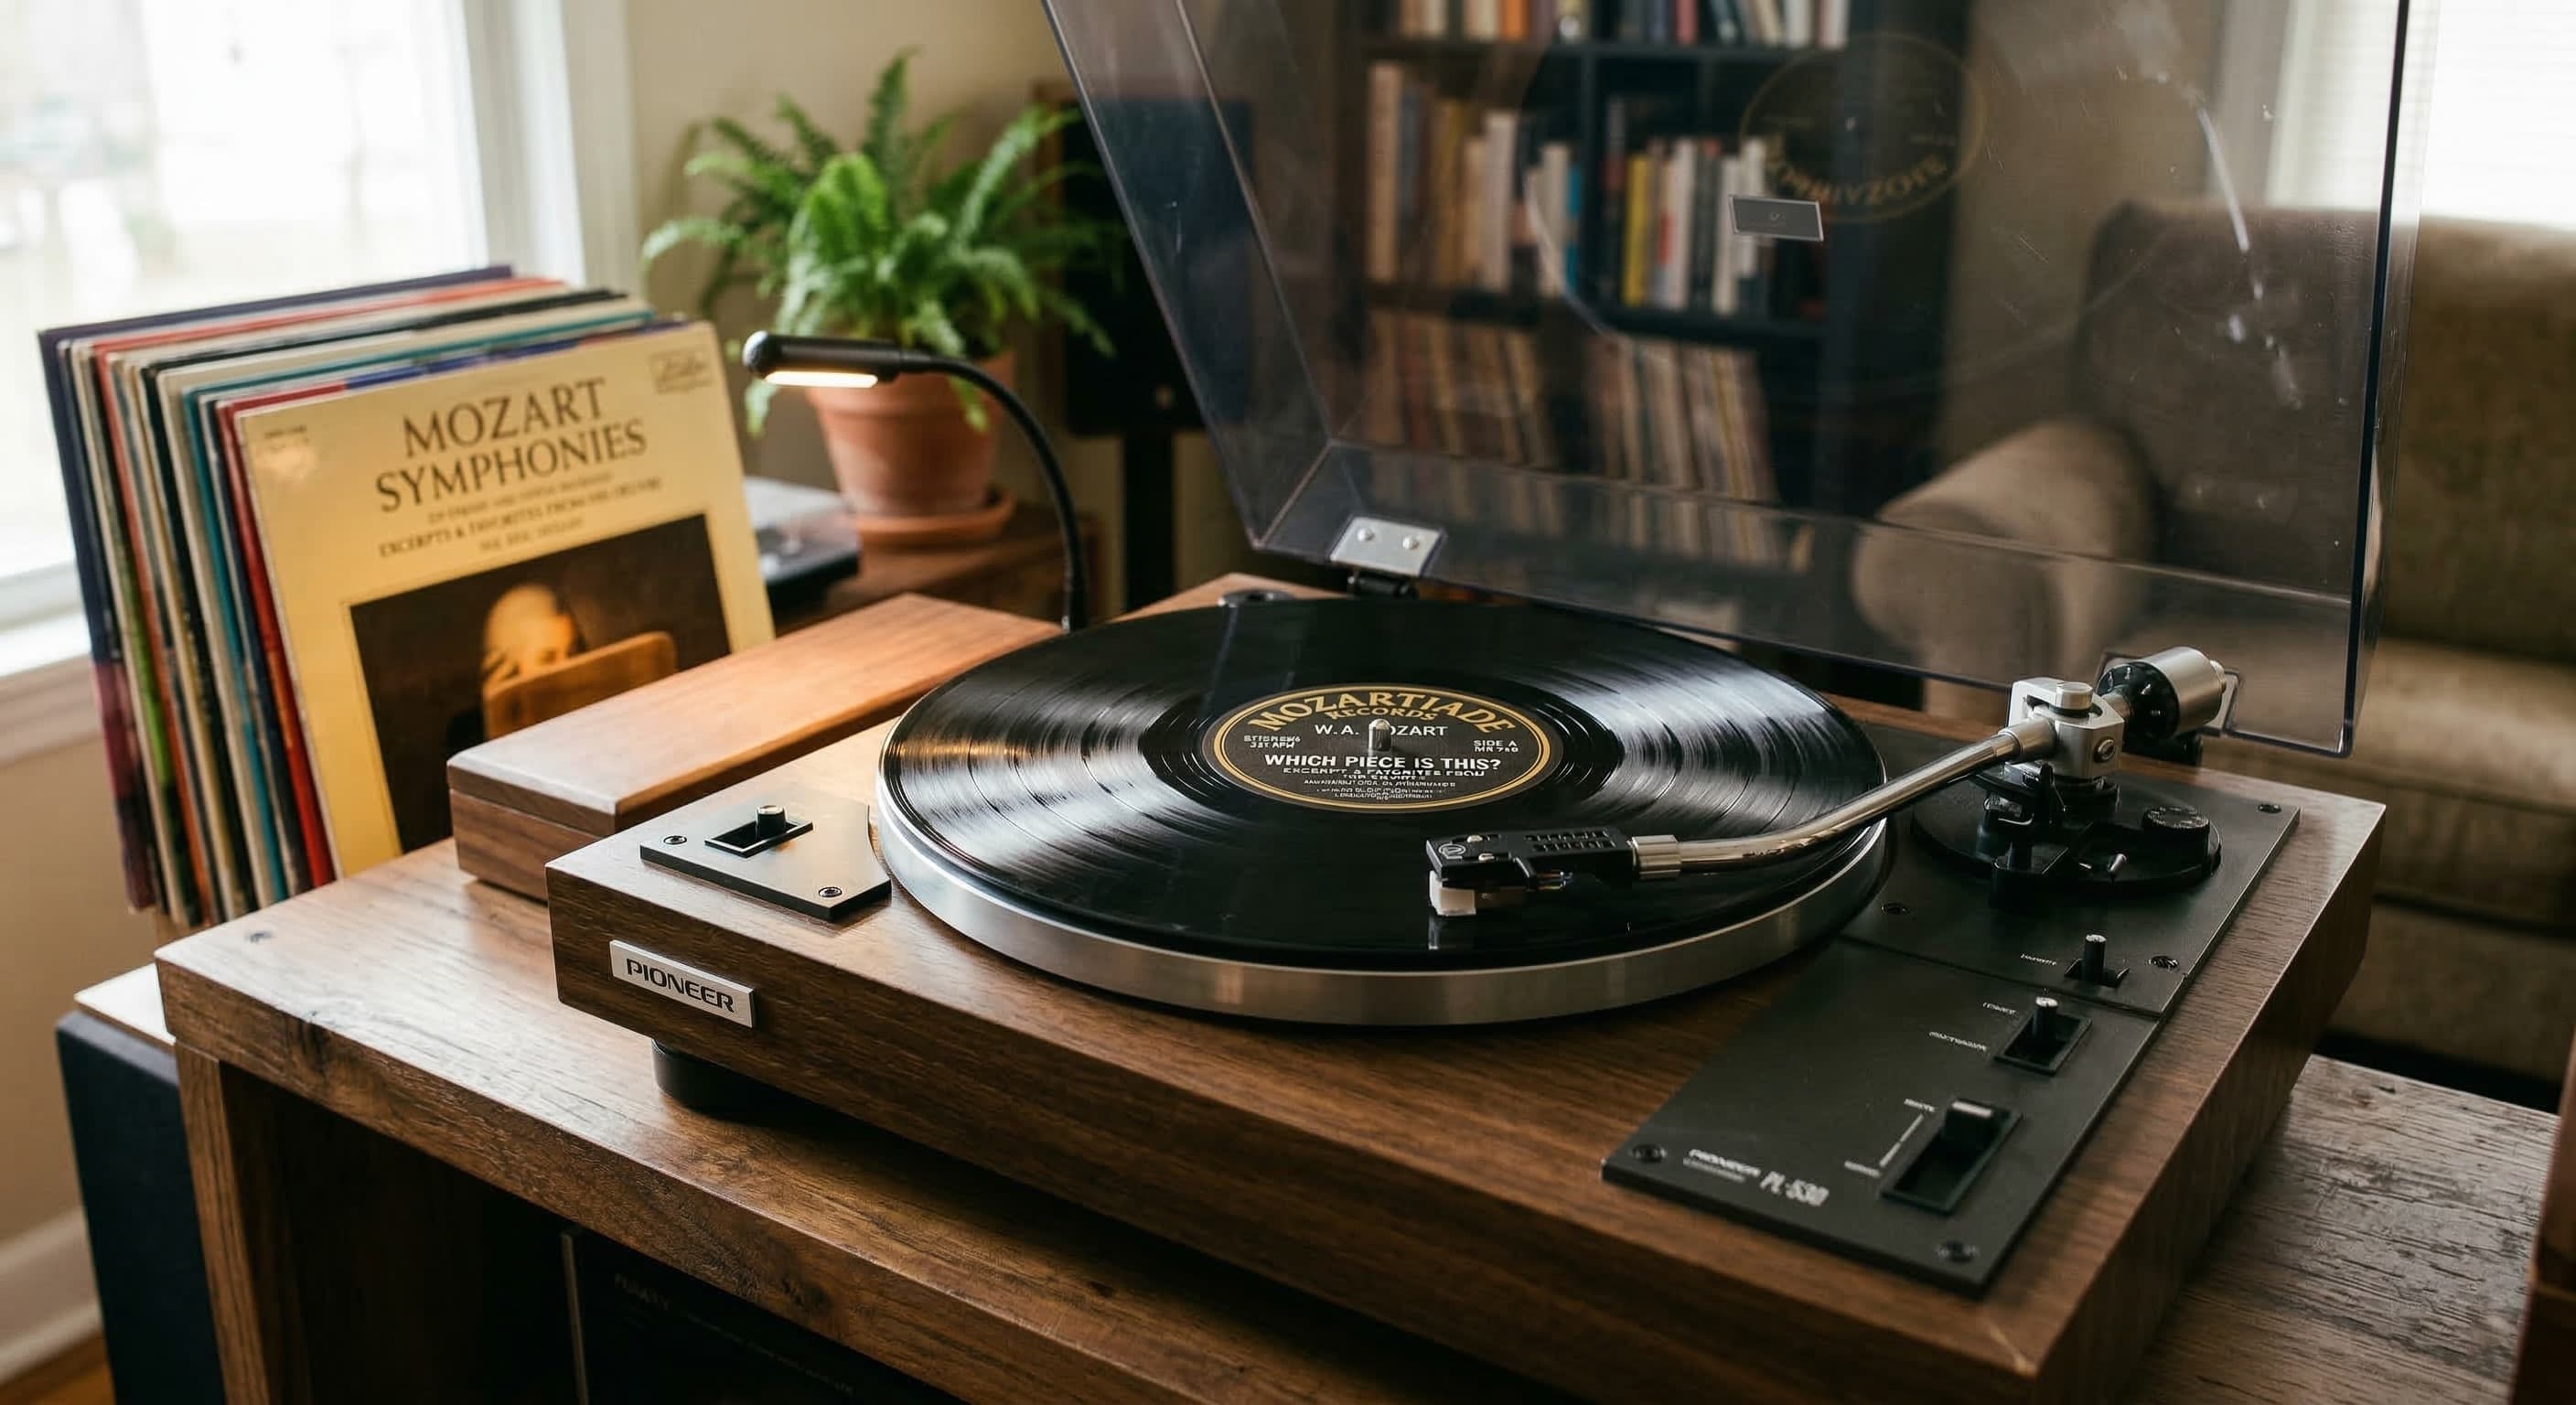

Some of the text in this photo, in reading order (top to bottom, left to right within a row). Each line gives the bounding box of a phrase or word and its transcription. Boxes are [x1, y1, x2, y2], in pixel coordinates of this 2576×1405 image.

[402, 378, 606, 457] MOZART
[376, 420, 648, 513] SYMPHONIES
[1248, 692, 1516, 733] MOZARTIADE
[1315, 724, 1448, 736] W.A. ZART
[1324, 707, 1438, 721] RECORDS
[1265, 755, 1501, 770] WHICH PIECE IS THIS?
[626, 958, 735, 1014] PIONEER
